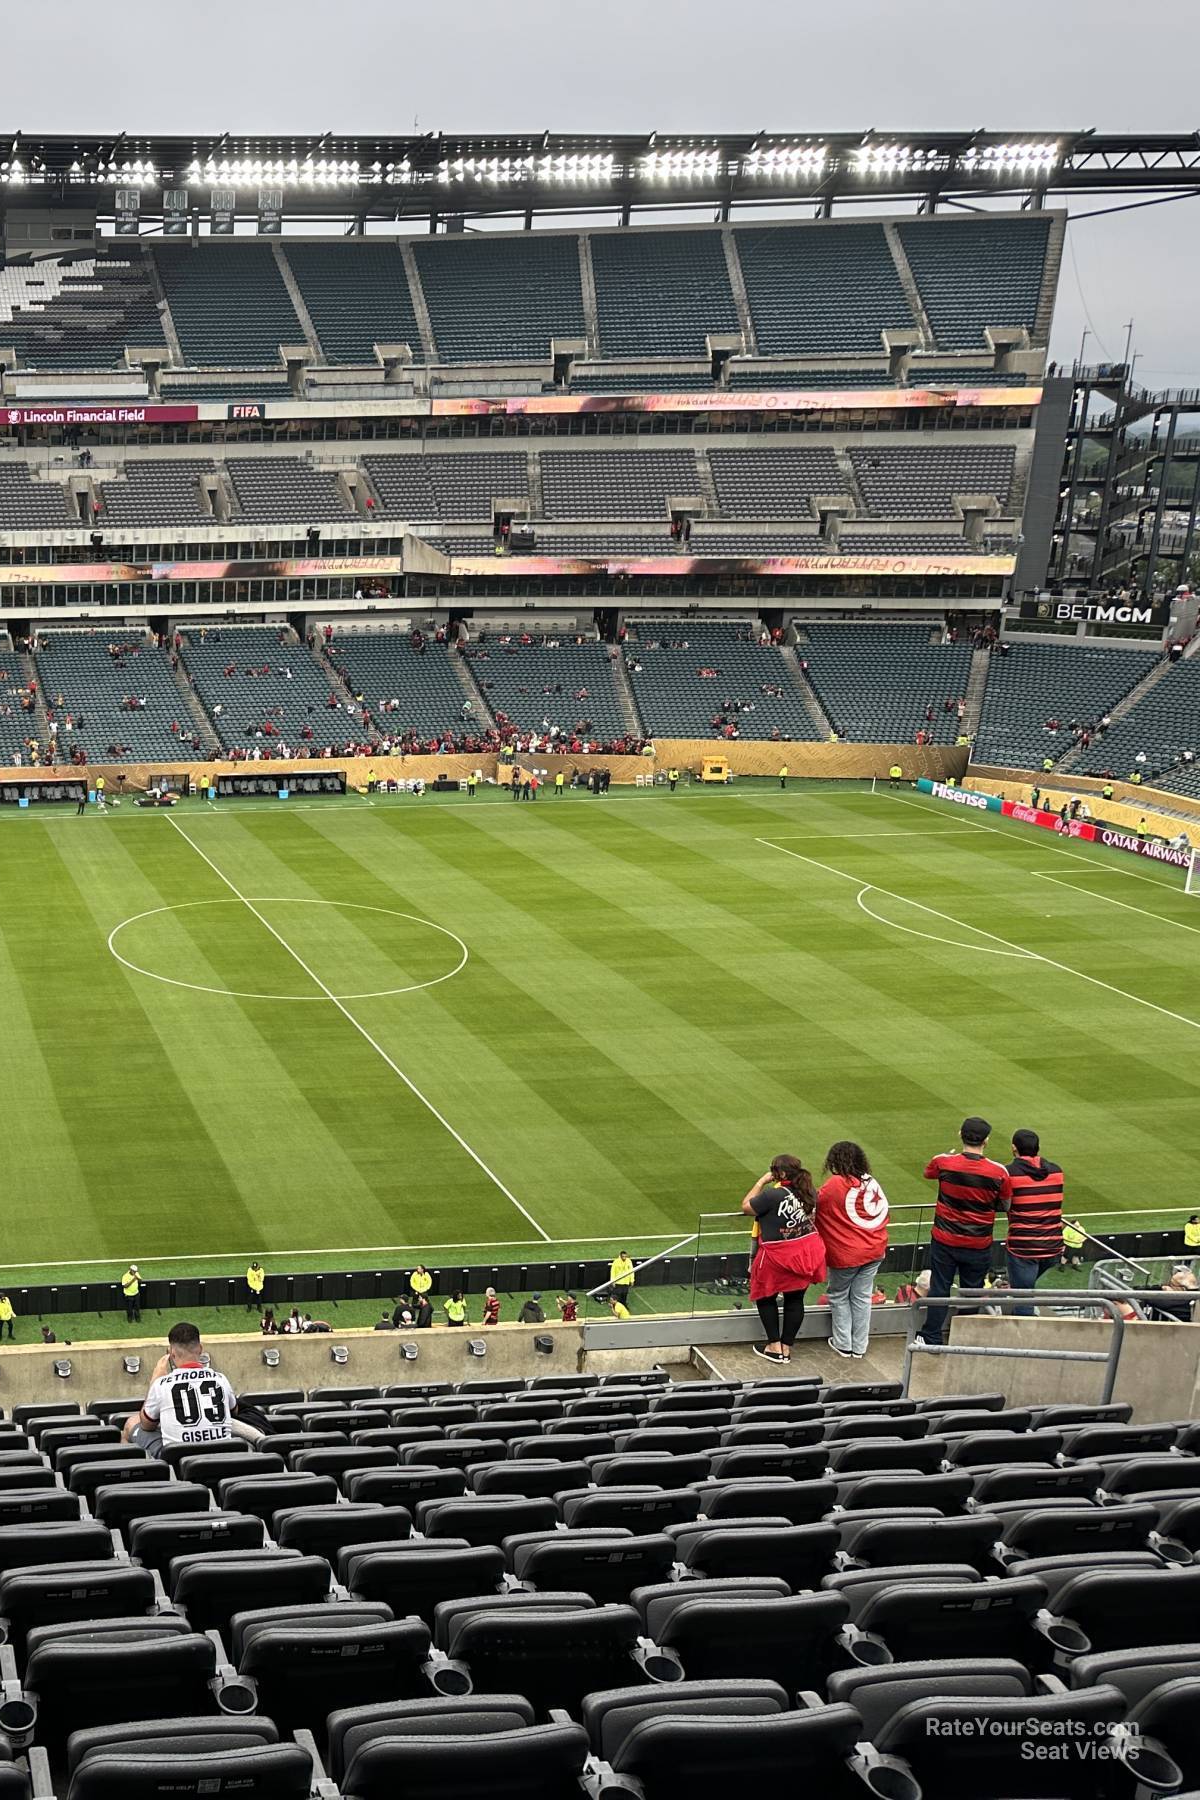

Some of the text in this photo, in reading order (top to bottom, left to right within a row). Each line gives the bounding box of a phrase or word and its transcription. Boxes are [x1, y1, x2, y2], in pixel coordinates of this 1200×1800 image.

[117, 190, 138, 210] 15
[165, 190, 185, 210] 40
[24, 409, 146, 423] Lincoln Financial Field
[232, 406, 260, 418] FIFA
[1056, 604, 1153, 624] BETMGM
[931, 781, 988, 811] Hisense
[1102, 830, 1139, 853] QATAR
[1141, 839, 1192, 869] AIRWAYS
[171, 1380, 226, 1428] 03
[181, 1426, 228, 1443] GISELLE
